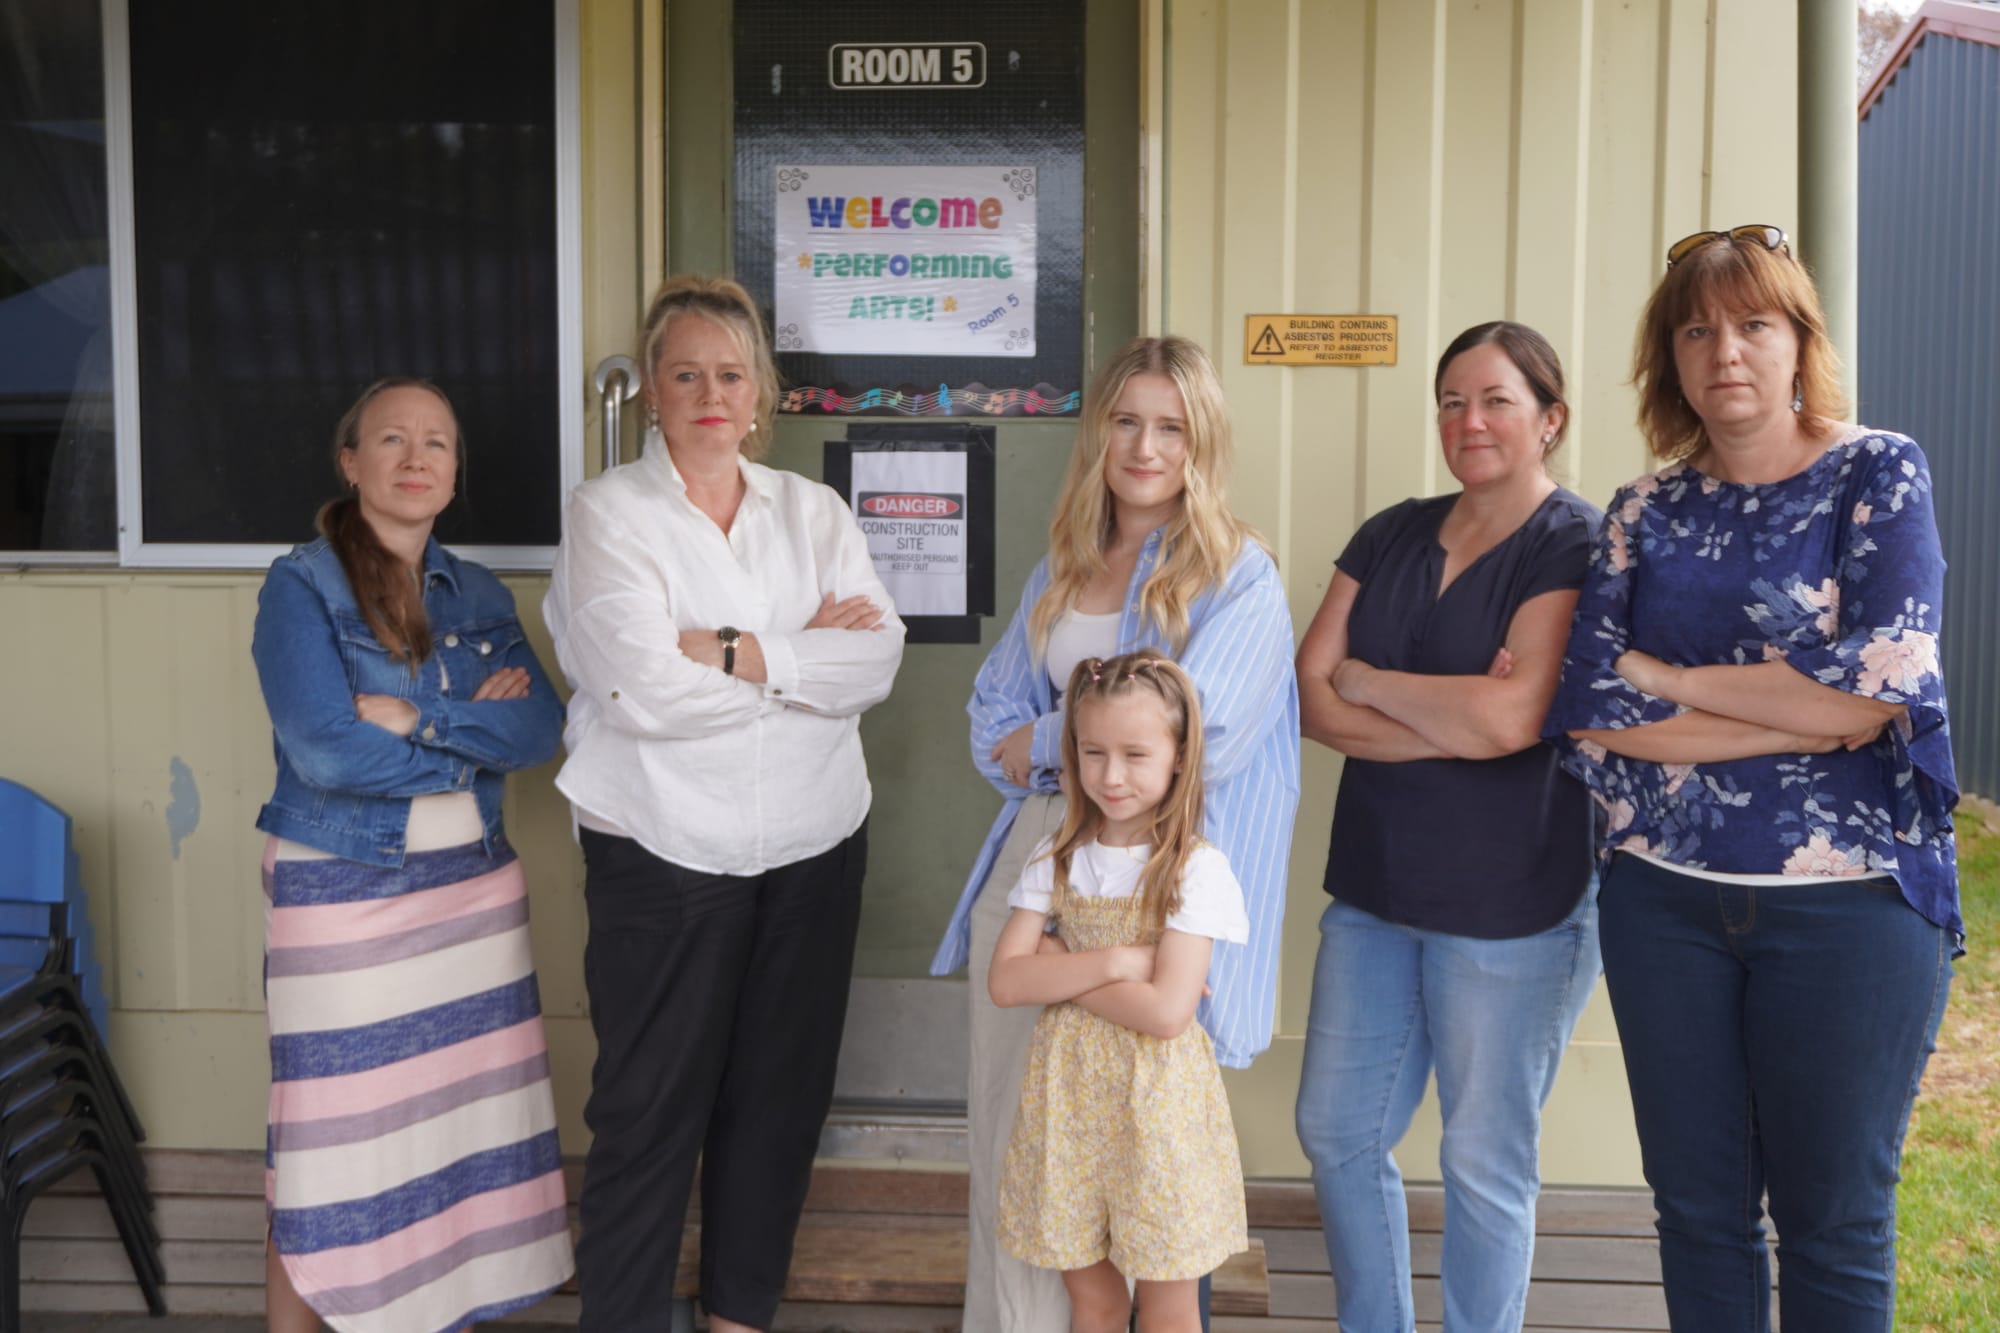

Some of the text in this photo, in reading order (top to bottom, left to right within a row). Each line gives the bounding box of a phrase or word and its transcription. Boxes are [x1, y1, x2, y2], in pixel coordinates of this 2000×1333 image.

[841, 48, 974, 84] ROOM 5
[967, 292, 1020, 335] Room 5
[1289, 320, 1388, 330] BUILDING CONTAINS
[1284, 332, 1393, 342] ASBESTOS PRODUCTS
[875, 498, 948, 514] DANGER
[862, 521, 959, 537] CONSTRUCTION
[896, 537, 925, 551] SITE
[923, 553, 959, 563] PERSONS
[891, 562, 929, 571] KEEP OUT
